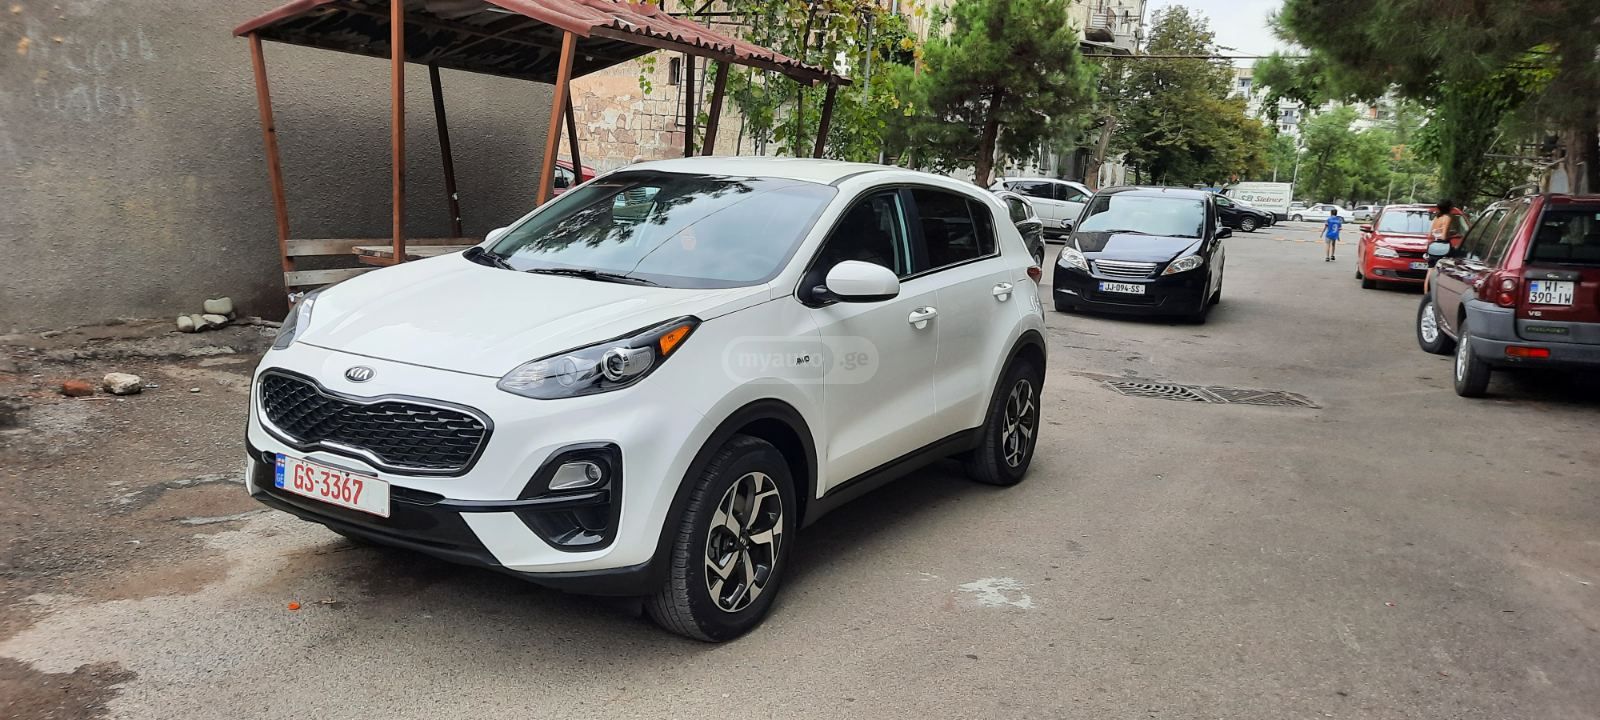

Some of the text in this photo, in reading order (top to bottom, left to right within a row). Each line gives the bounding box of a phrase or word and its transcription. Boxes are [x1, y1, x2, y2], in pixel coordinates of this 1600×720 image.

[1105, 283, 1140, 293] JJ-094-SS
[1530, 292, 1571, 304] 390-IW
[346, 367, 370, 380] KIA
[293, 463, 364, 505] GS-3367
